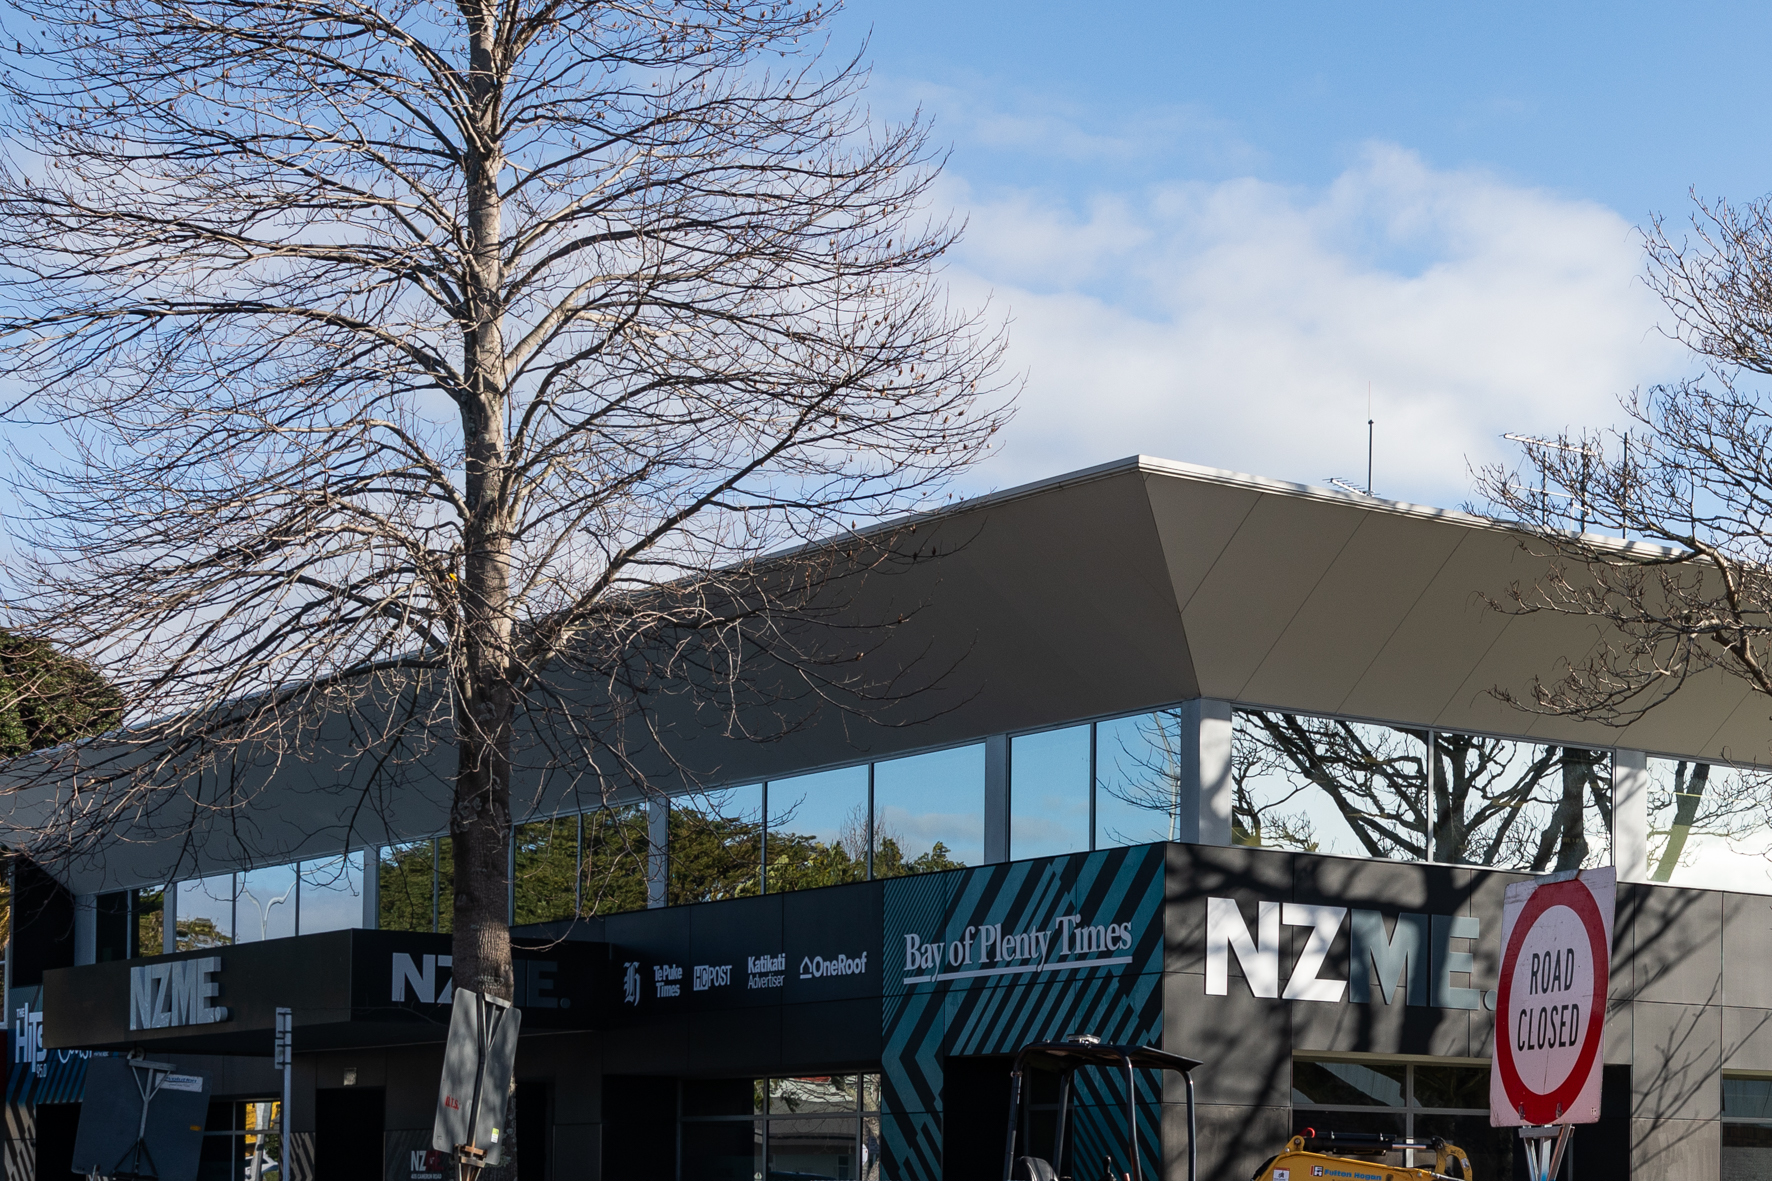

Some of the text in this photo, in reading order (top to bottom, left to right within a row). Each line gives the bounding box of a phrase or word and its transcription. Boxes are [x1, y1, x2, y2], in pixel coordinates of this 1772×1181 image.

[903, 913, 1132, 983] Bay of Plenty Times
[653, 964, 683, 982] Te Puke
[747, 953, 786, 974] Katikati
[812, 951, 867, 978] OneRoof
[1528, 947, 1575, 996] ROAD
[129, 956, 228, 1031] NZME.
[656, 982, 681, 998] Times
[747, 973, 785, 990] Advertiser
[1516, 1002, 1581, 1052] CLOSED
[1324, 1168, 1352, 1178] Fulton
[1353, 1171, 1382, 1181] Hogan
